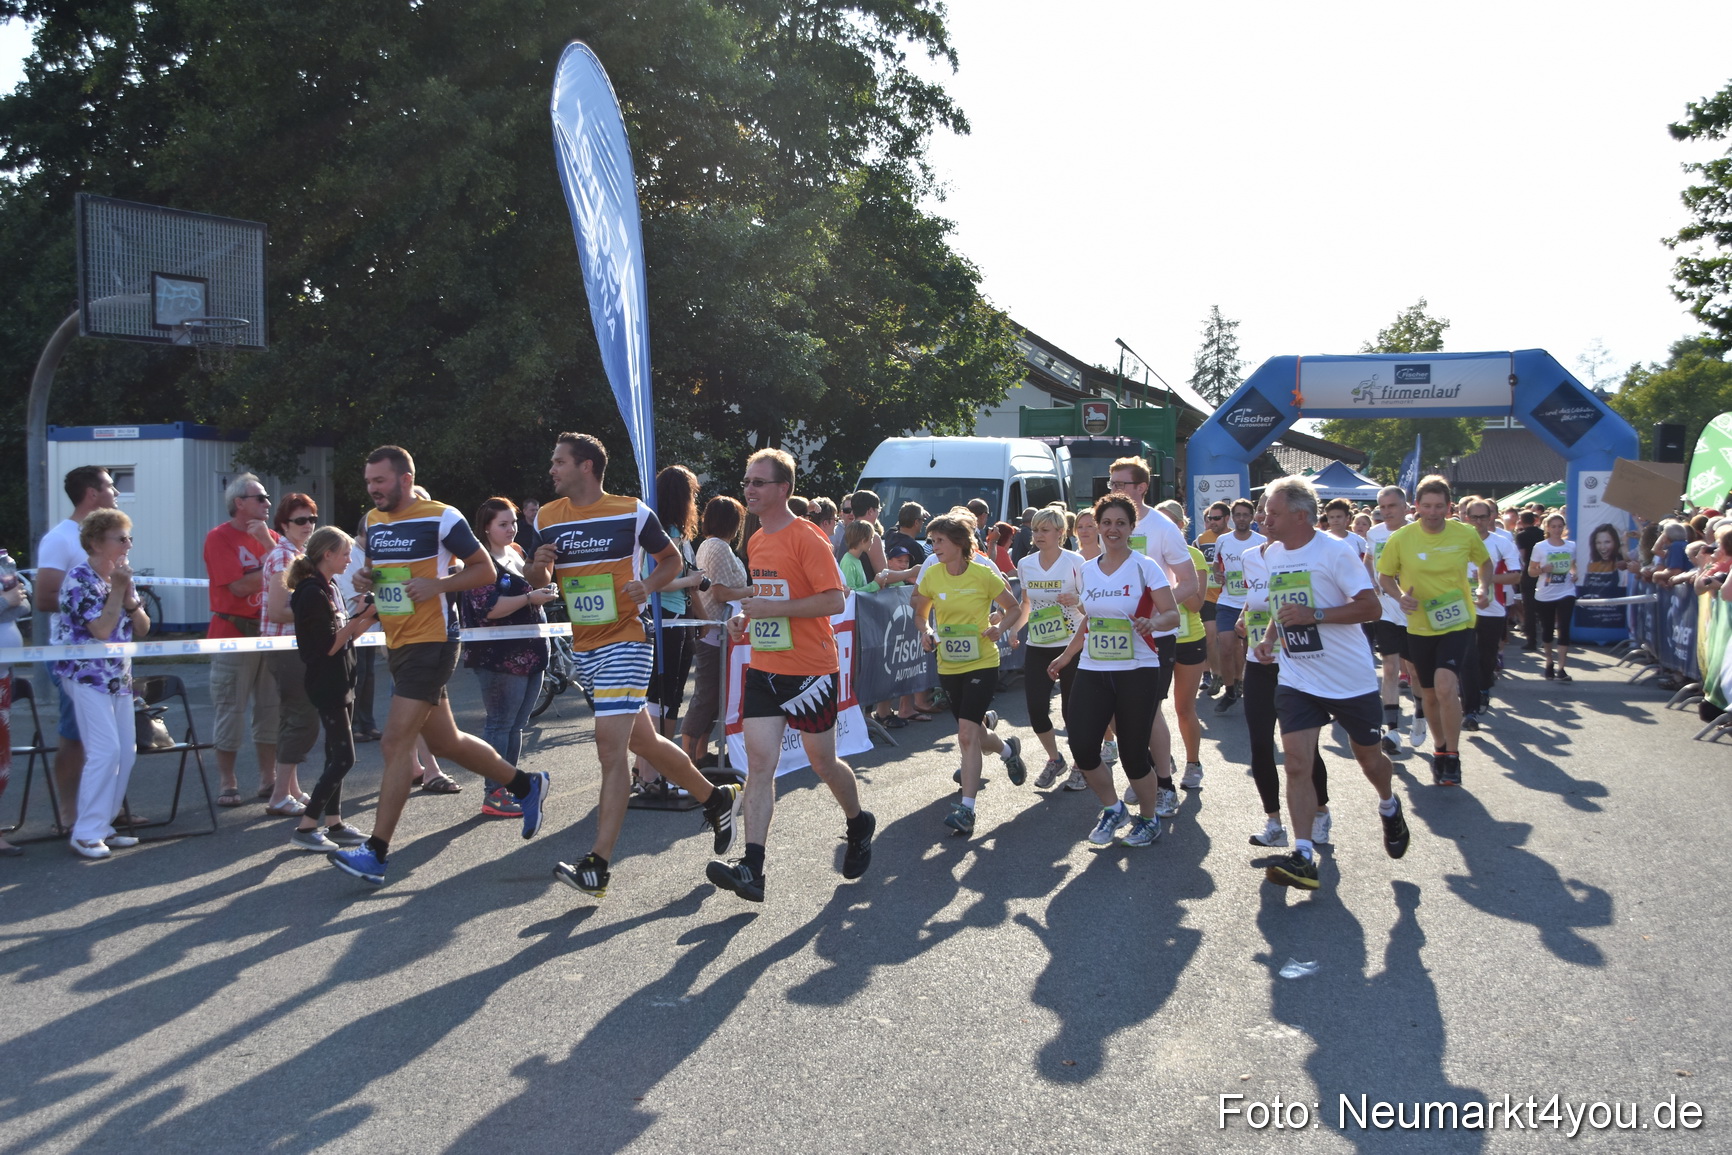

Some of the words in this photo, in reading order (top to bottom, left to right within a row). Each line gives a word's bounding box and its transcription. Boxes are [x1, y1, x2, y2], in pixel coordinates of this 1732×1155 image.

[1381, 384, 1461, 399] firmenlauf
[1234, 414, 1276, 423] Fischer
[373, 537, 417, 548] Fischer
[562, 537, 614, 550] Fischer
[568, 546, 609, 555] AUTOMOBILE
[752, 569, 760, 577] 30
[762, 569, 777, 577] Jahre
[379, 587, 403, 602] 408
[1085, 584, 1130, 601] Xplus1
[574, 595, 604, 612] 409
[1435, 605, 1461, 622] 635
[755, 622, 780, 637] 622
[1032, 620, 1062, 636] 1022
[1092, 634, 1128, 650] 1512
[1287, 630, 1310, 646] RW
[945, 640, 971, 652] 629
